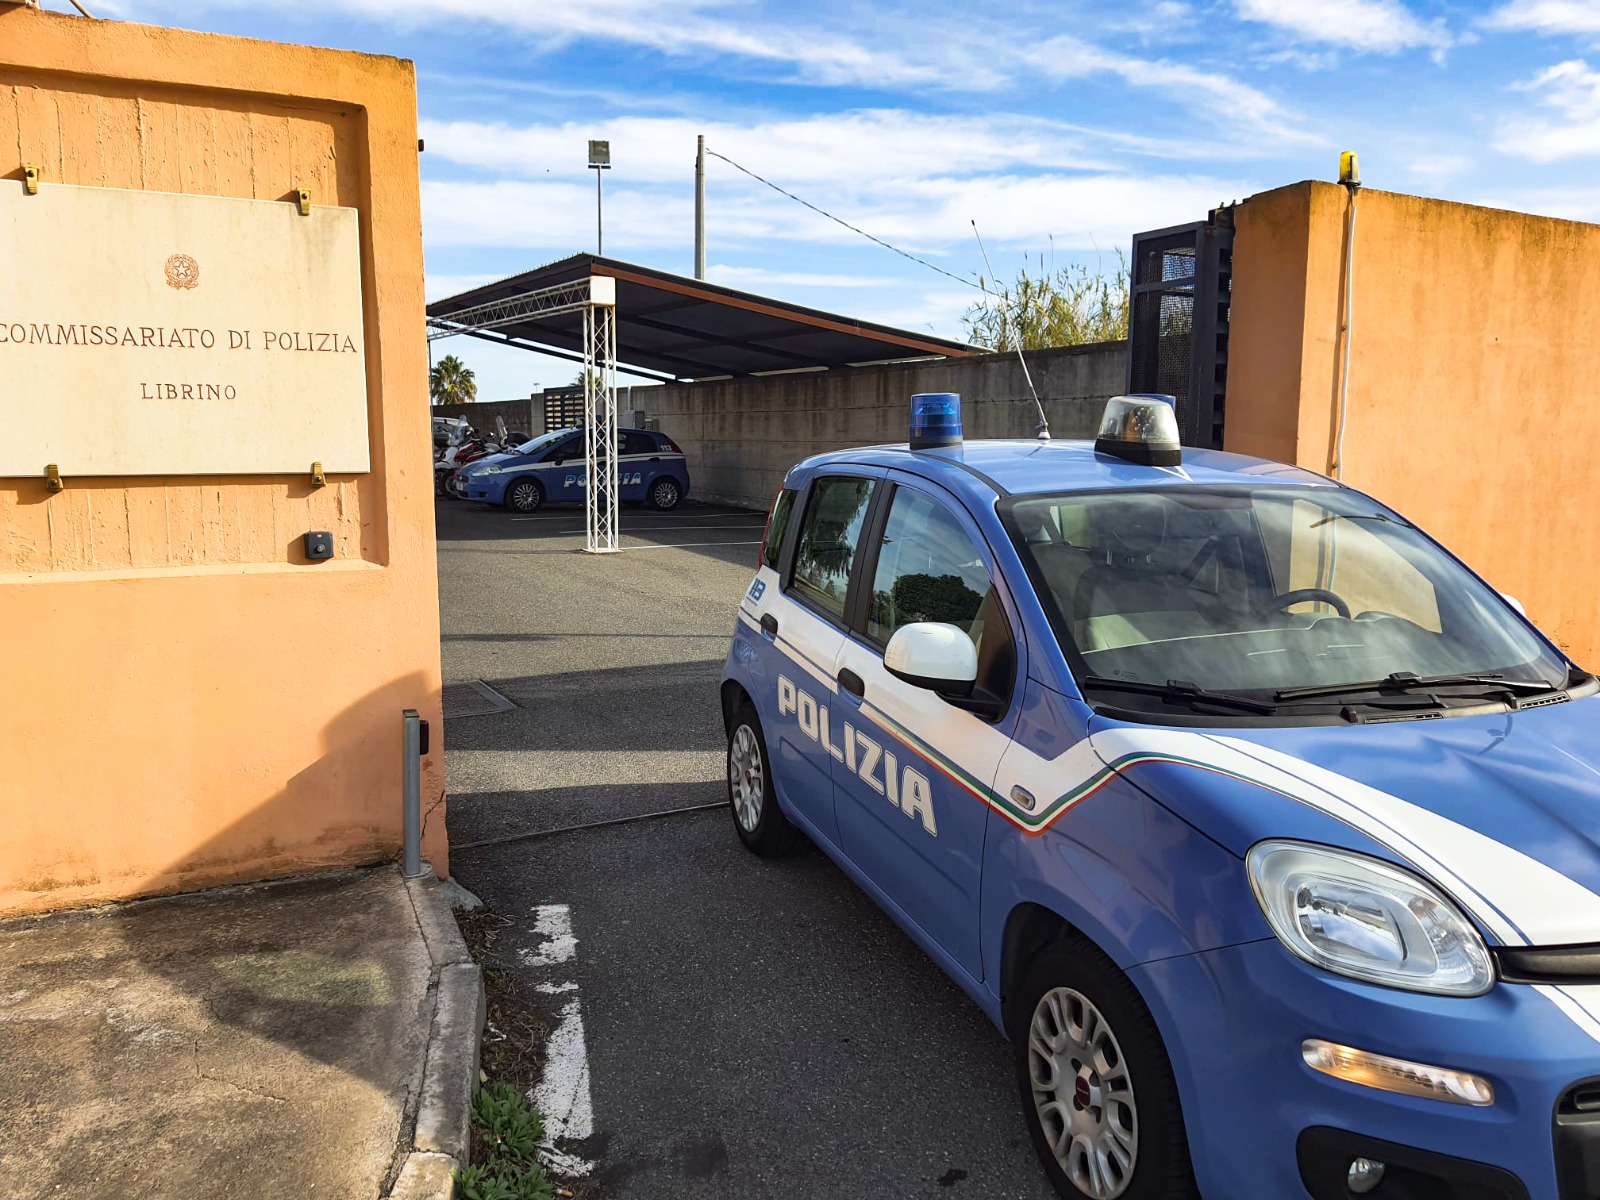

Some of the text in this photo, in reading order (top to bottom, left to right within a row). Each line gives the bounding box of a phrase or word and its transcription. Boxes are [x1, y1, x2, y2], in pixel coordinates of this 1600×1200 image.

[228, 330, 250, 350] DI
[263, 332, 357, 353] POLIZIA
[141, 383, 237, 400] LIBRINO
[563, 472, 642, 488] POIA
[777, 673, 938, 837] POLIZIA
